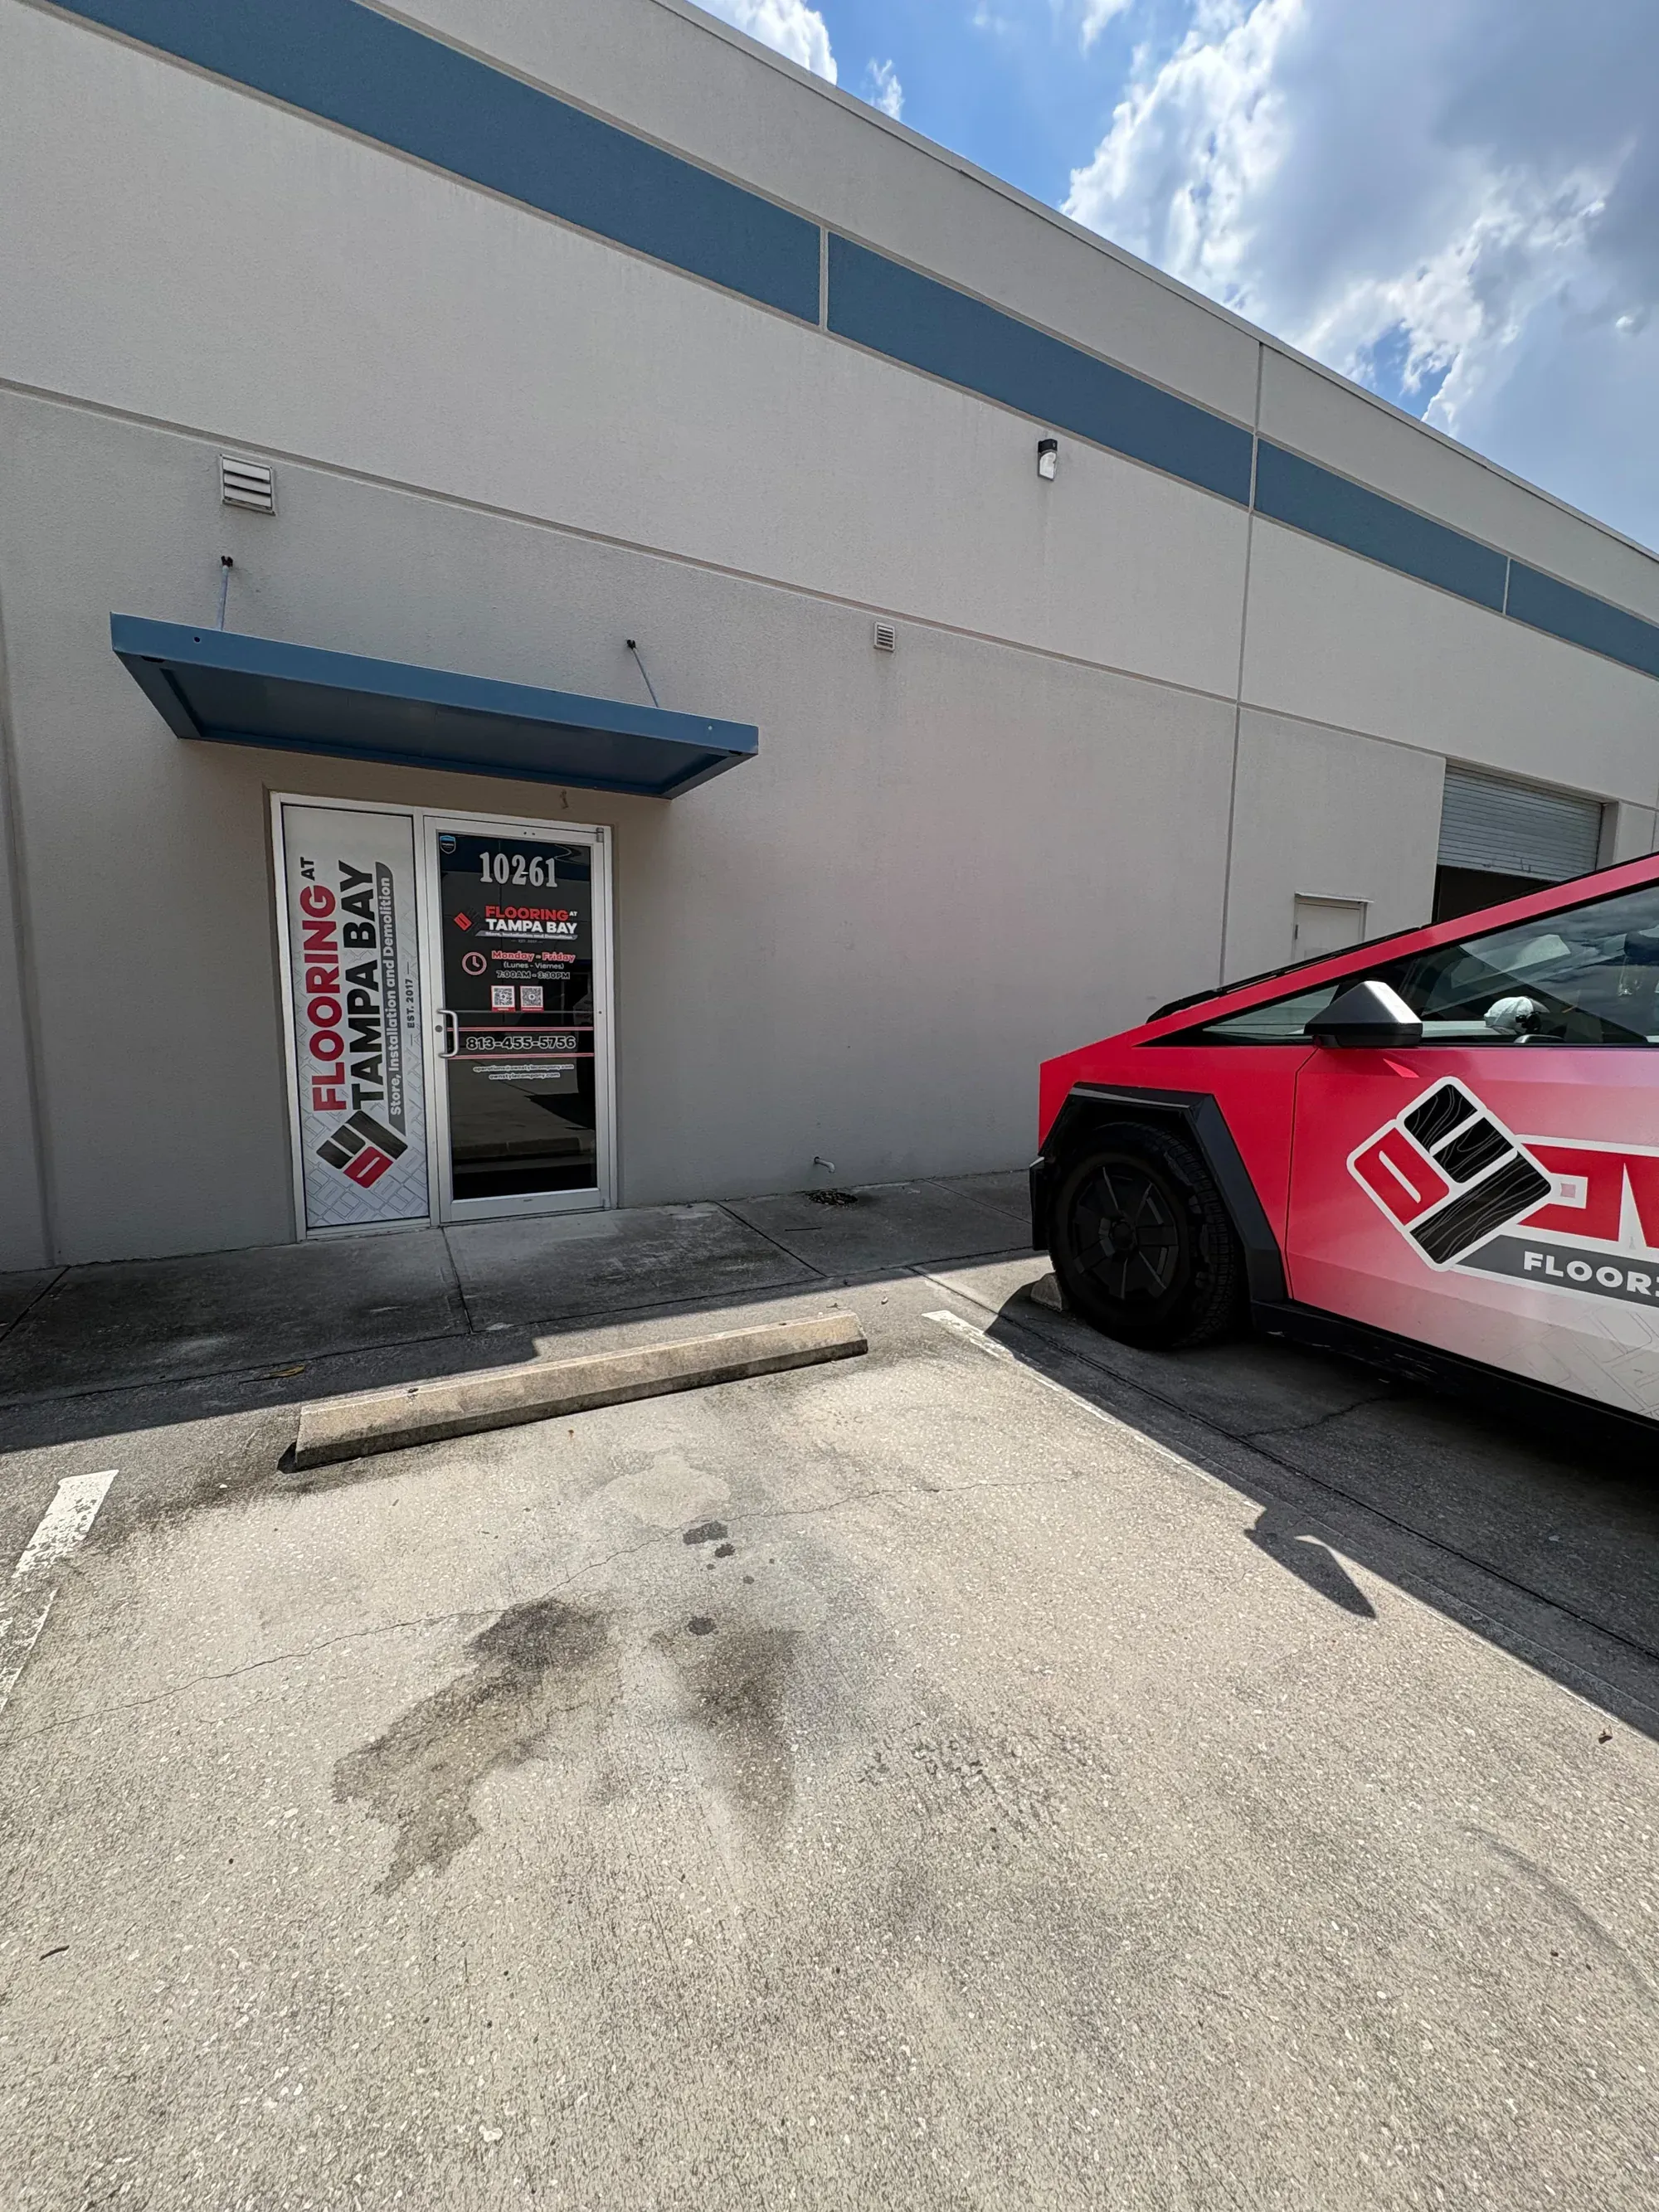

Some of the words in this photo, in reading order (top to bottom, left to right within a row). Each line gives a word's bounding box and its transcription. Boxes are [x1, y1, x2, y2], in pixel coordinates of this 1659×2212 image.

[299, 857, 315, 881] AT
[479, 851, 558, 887] 10261
[338, 859, 377, 949] BAY
[379, 877, 394, 957] Demolition
[484, 905, 569, 921] FLOORING
[485, 919, 543, 933] TAMPA
[546, 921, 578, 935] BAY
[491, 950, 535, 962] Monday
[542, 951, 576, 963] Friday
[504, 961, 529, 970] (Lunes
[382, 959, 396, 987] and
[496, 970, 531, 979] 7:00AM
[538, 971, 570, 980] 3:30PM
[299, 885, 347, 1111] FLOORING
[405, 978, 414, 1004] 2017
[406, 1005, 415, 1028] EST.
[345, 960, 384, 1110] TAMPA
[384, 990, 399, 1071] Installation
[466, 1036, 577, 1050] 813-455-5756
[489, 1072, 561, 1081] ownstylecompany.com
[390, 1073, 402, 1116] Store,
[1523, 1250, 1659, 1297] FLOOR
